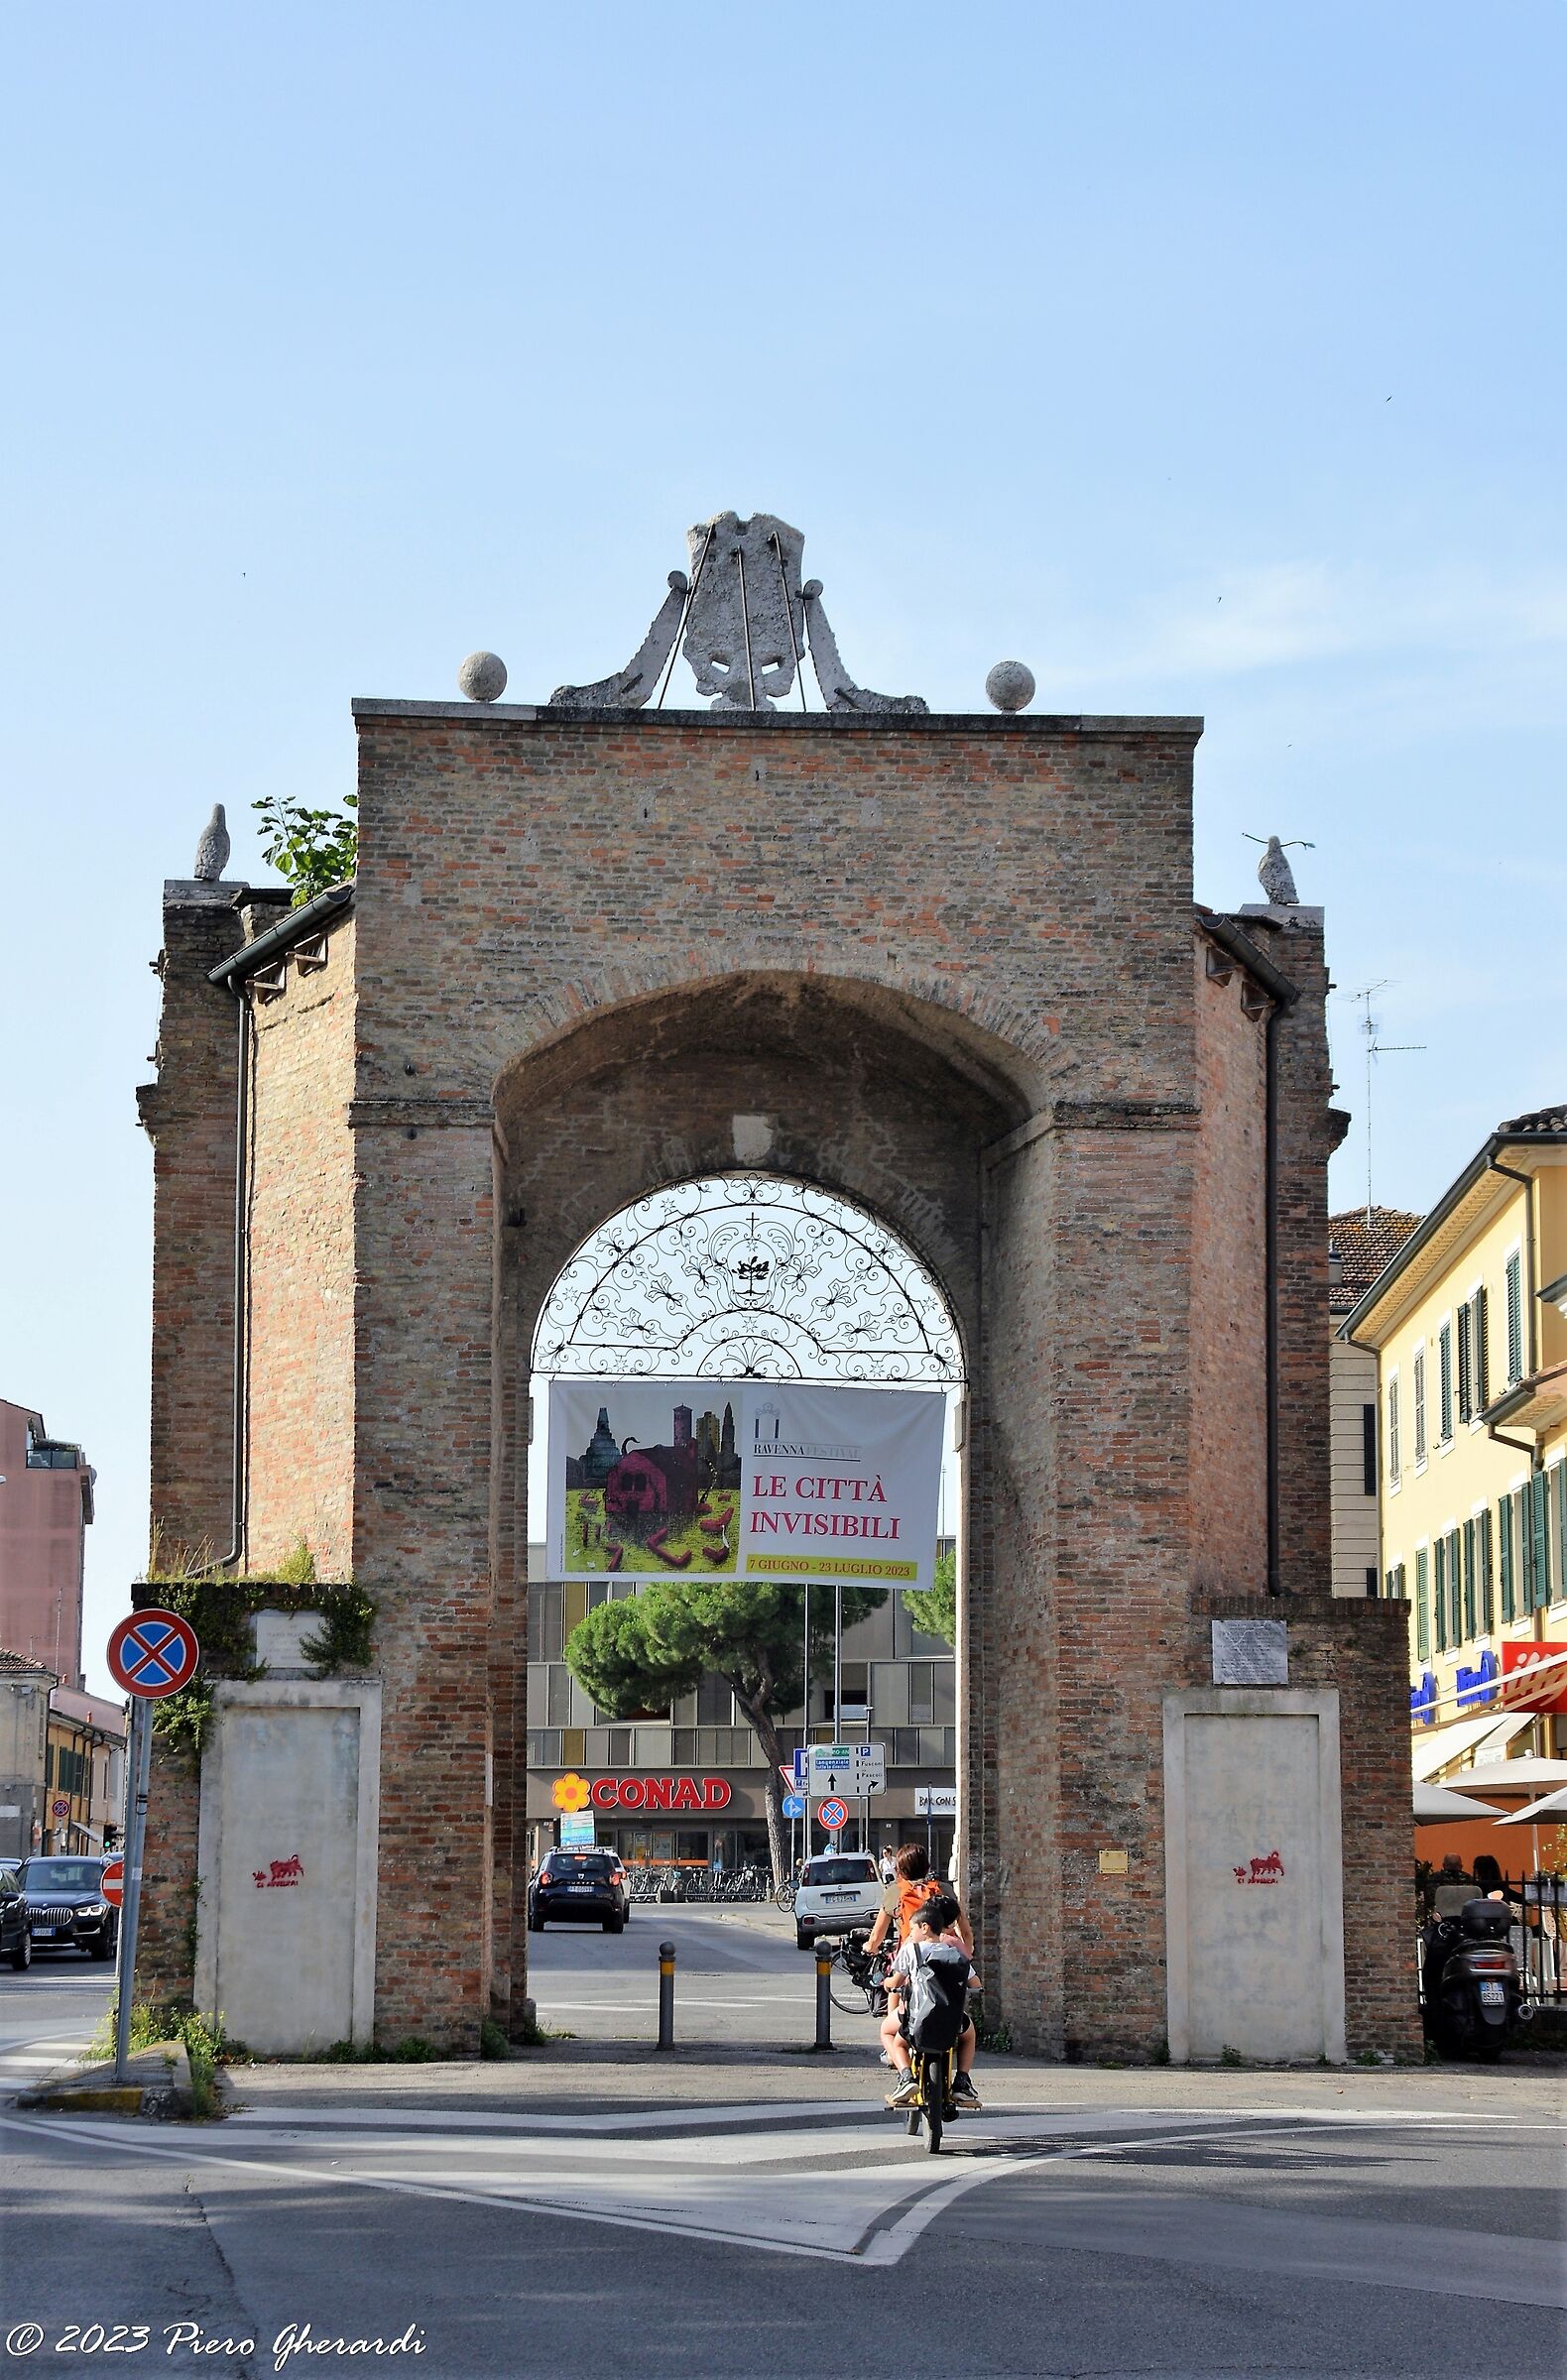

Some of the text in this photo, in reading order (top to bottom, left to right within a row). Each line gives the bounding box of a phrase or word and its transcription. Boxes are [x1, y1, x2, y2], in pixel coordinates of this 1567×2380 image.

[754, 1444, 858, 1459] RAVENNA FESTIVAL
[752, 1475, 888, 1502] LE CITTÀ
[750, 1511, 901, 1540] INVISIBILI
[750, 1559, 756, 1569] 7
[758, 1559, 809, 1571] GIUGNO
[819, 1562, 831, 1572] 23
[834, 1563, 883, 1575] LUGLIO
[885, 1566, 909, 1576] 2023
[591, 1777, 732, 1809] CONAD
